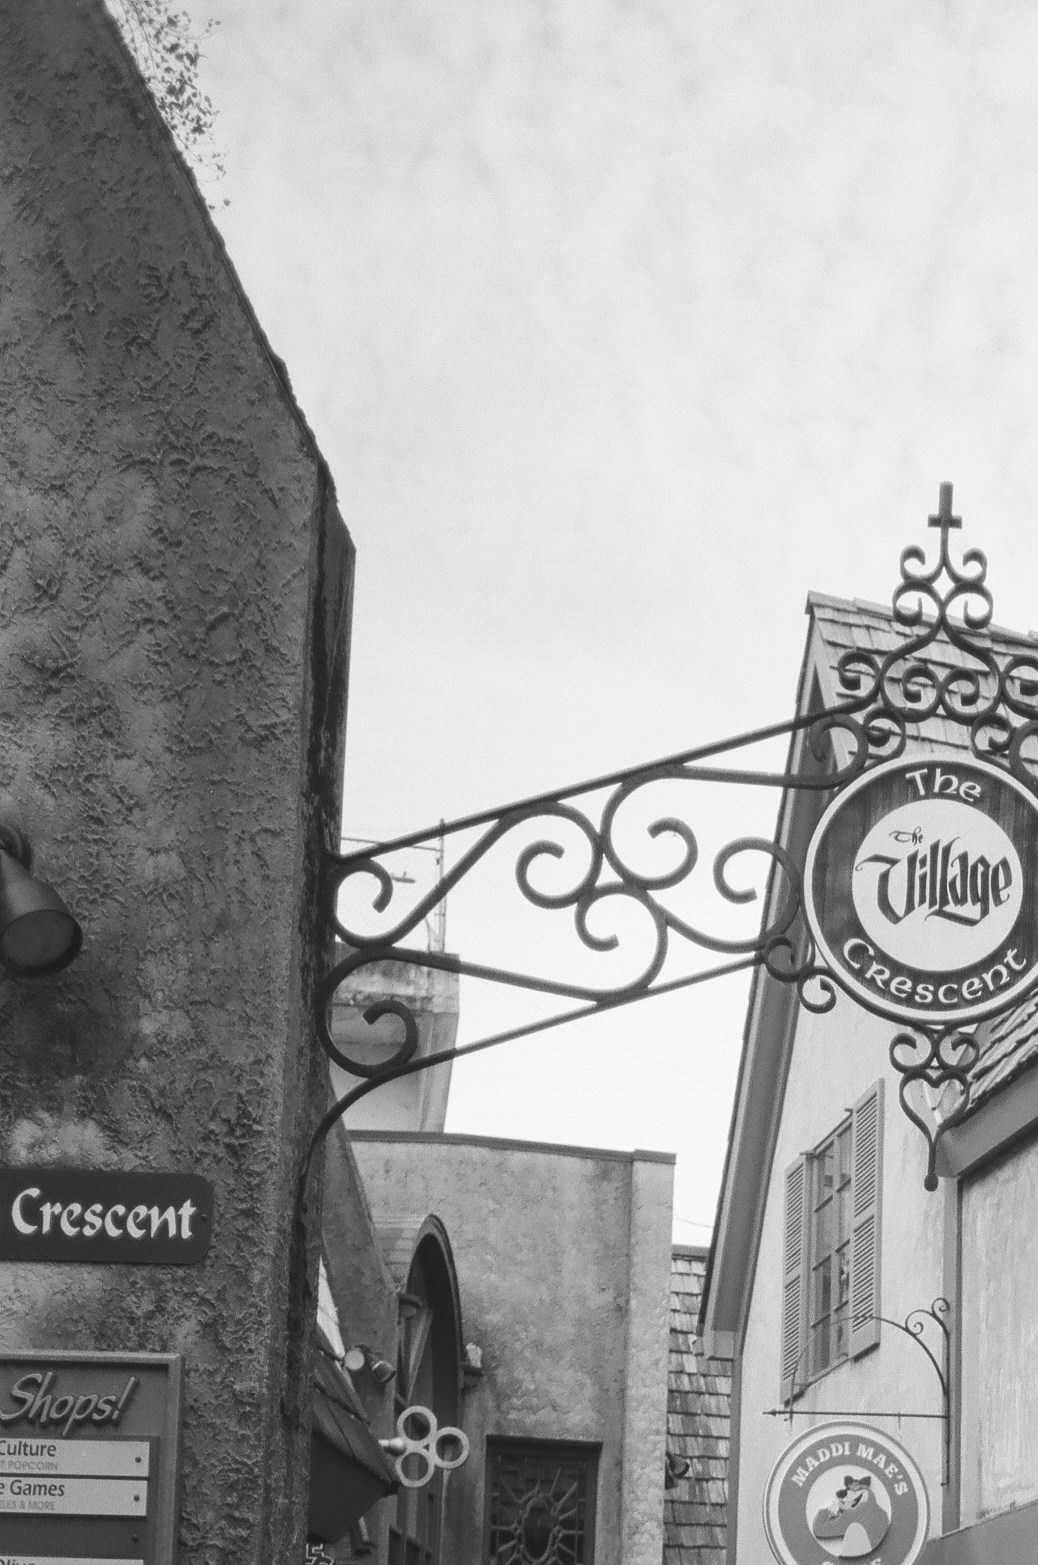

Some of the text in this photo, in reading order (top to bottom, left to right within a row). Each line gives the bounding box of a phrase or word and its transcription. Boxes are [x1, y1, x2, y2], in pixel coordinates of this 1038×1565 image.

[905, 768, 982, 801] The
[889, 826, 923, 845] The
[855, 837, 1013, 927] Village
[843, 938, 1027, 1004] Crescent
[11, 1187, 197, 1239] Crescent
[0, 1372, 137, 1437] Shops!
[8, 1460, 58, 1471] POPCORN
[791, 1441, 909, 1496] MADDI MAE'S
[10, 1479, 65, 1496] Games
[28, 1501, 57, 1511] MORE
